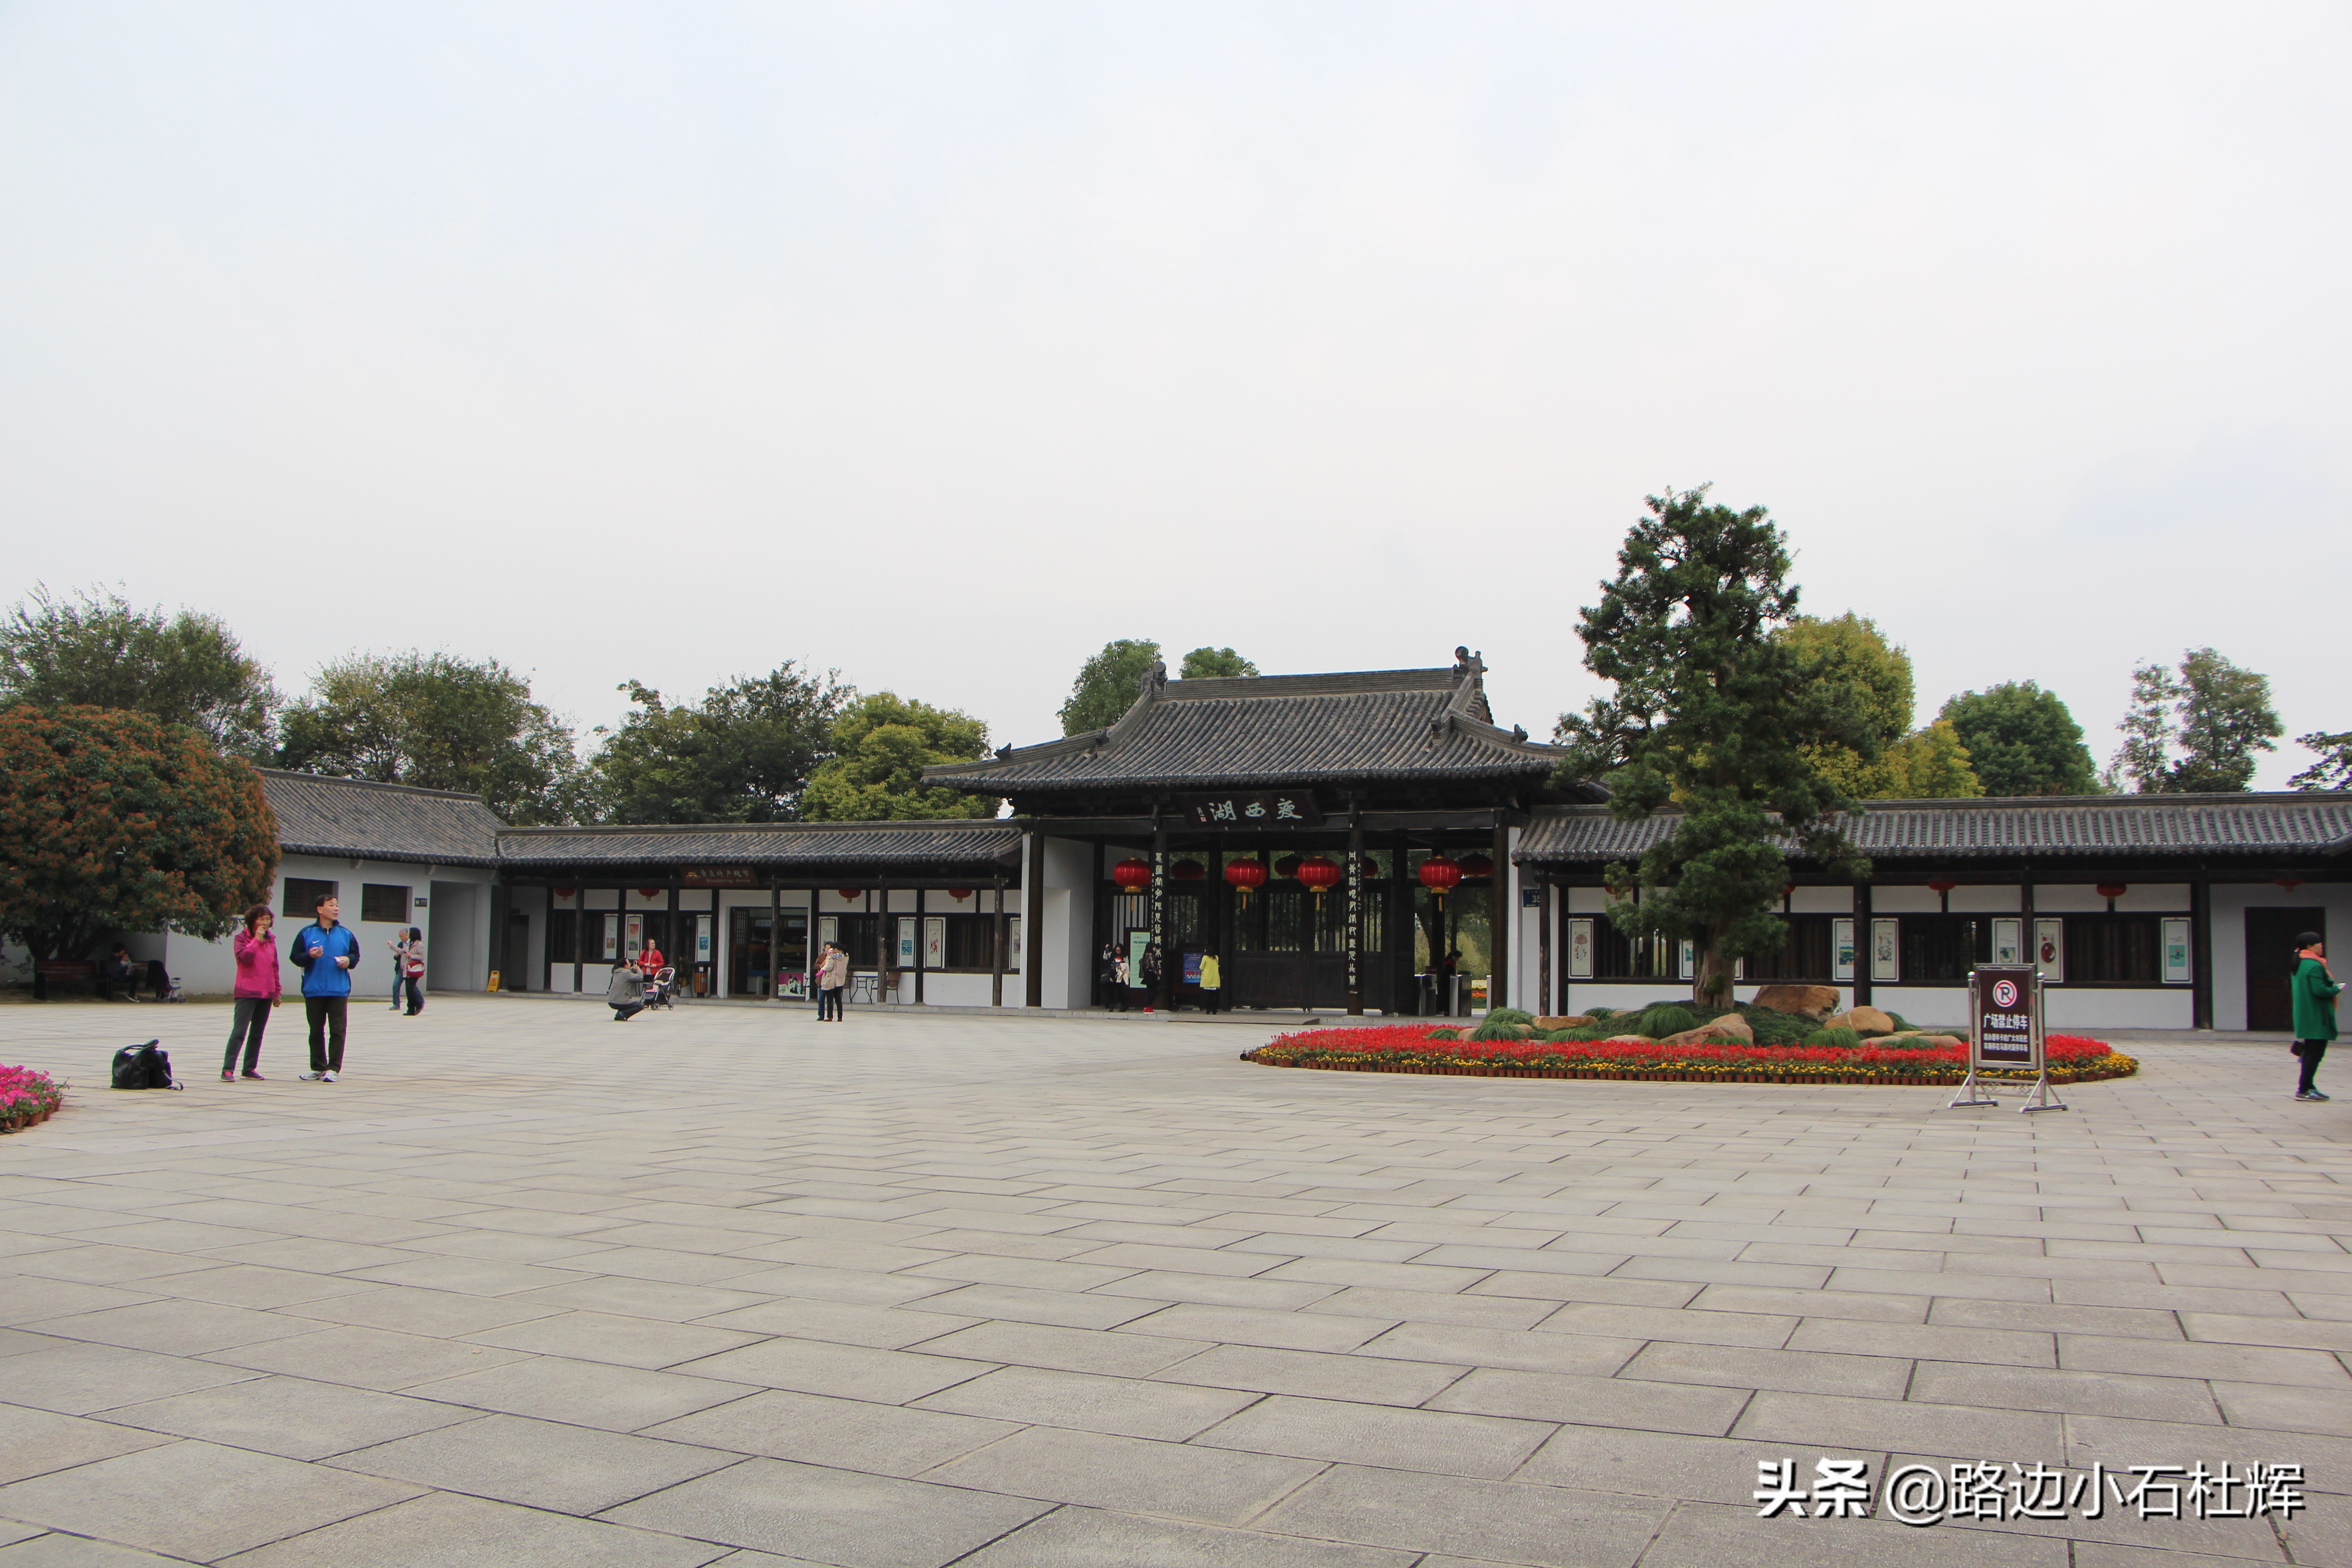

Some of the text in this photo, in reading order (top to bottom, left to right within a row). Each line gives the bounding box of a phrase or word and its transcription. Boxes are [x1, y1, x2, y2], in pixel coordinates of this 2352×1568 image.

[1209, 799, 1303, 821] 瘦西湖
[1983, 1013, 2028, 1029] 广场禁止停车
